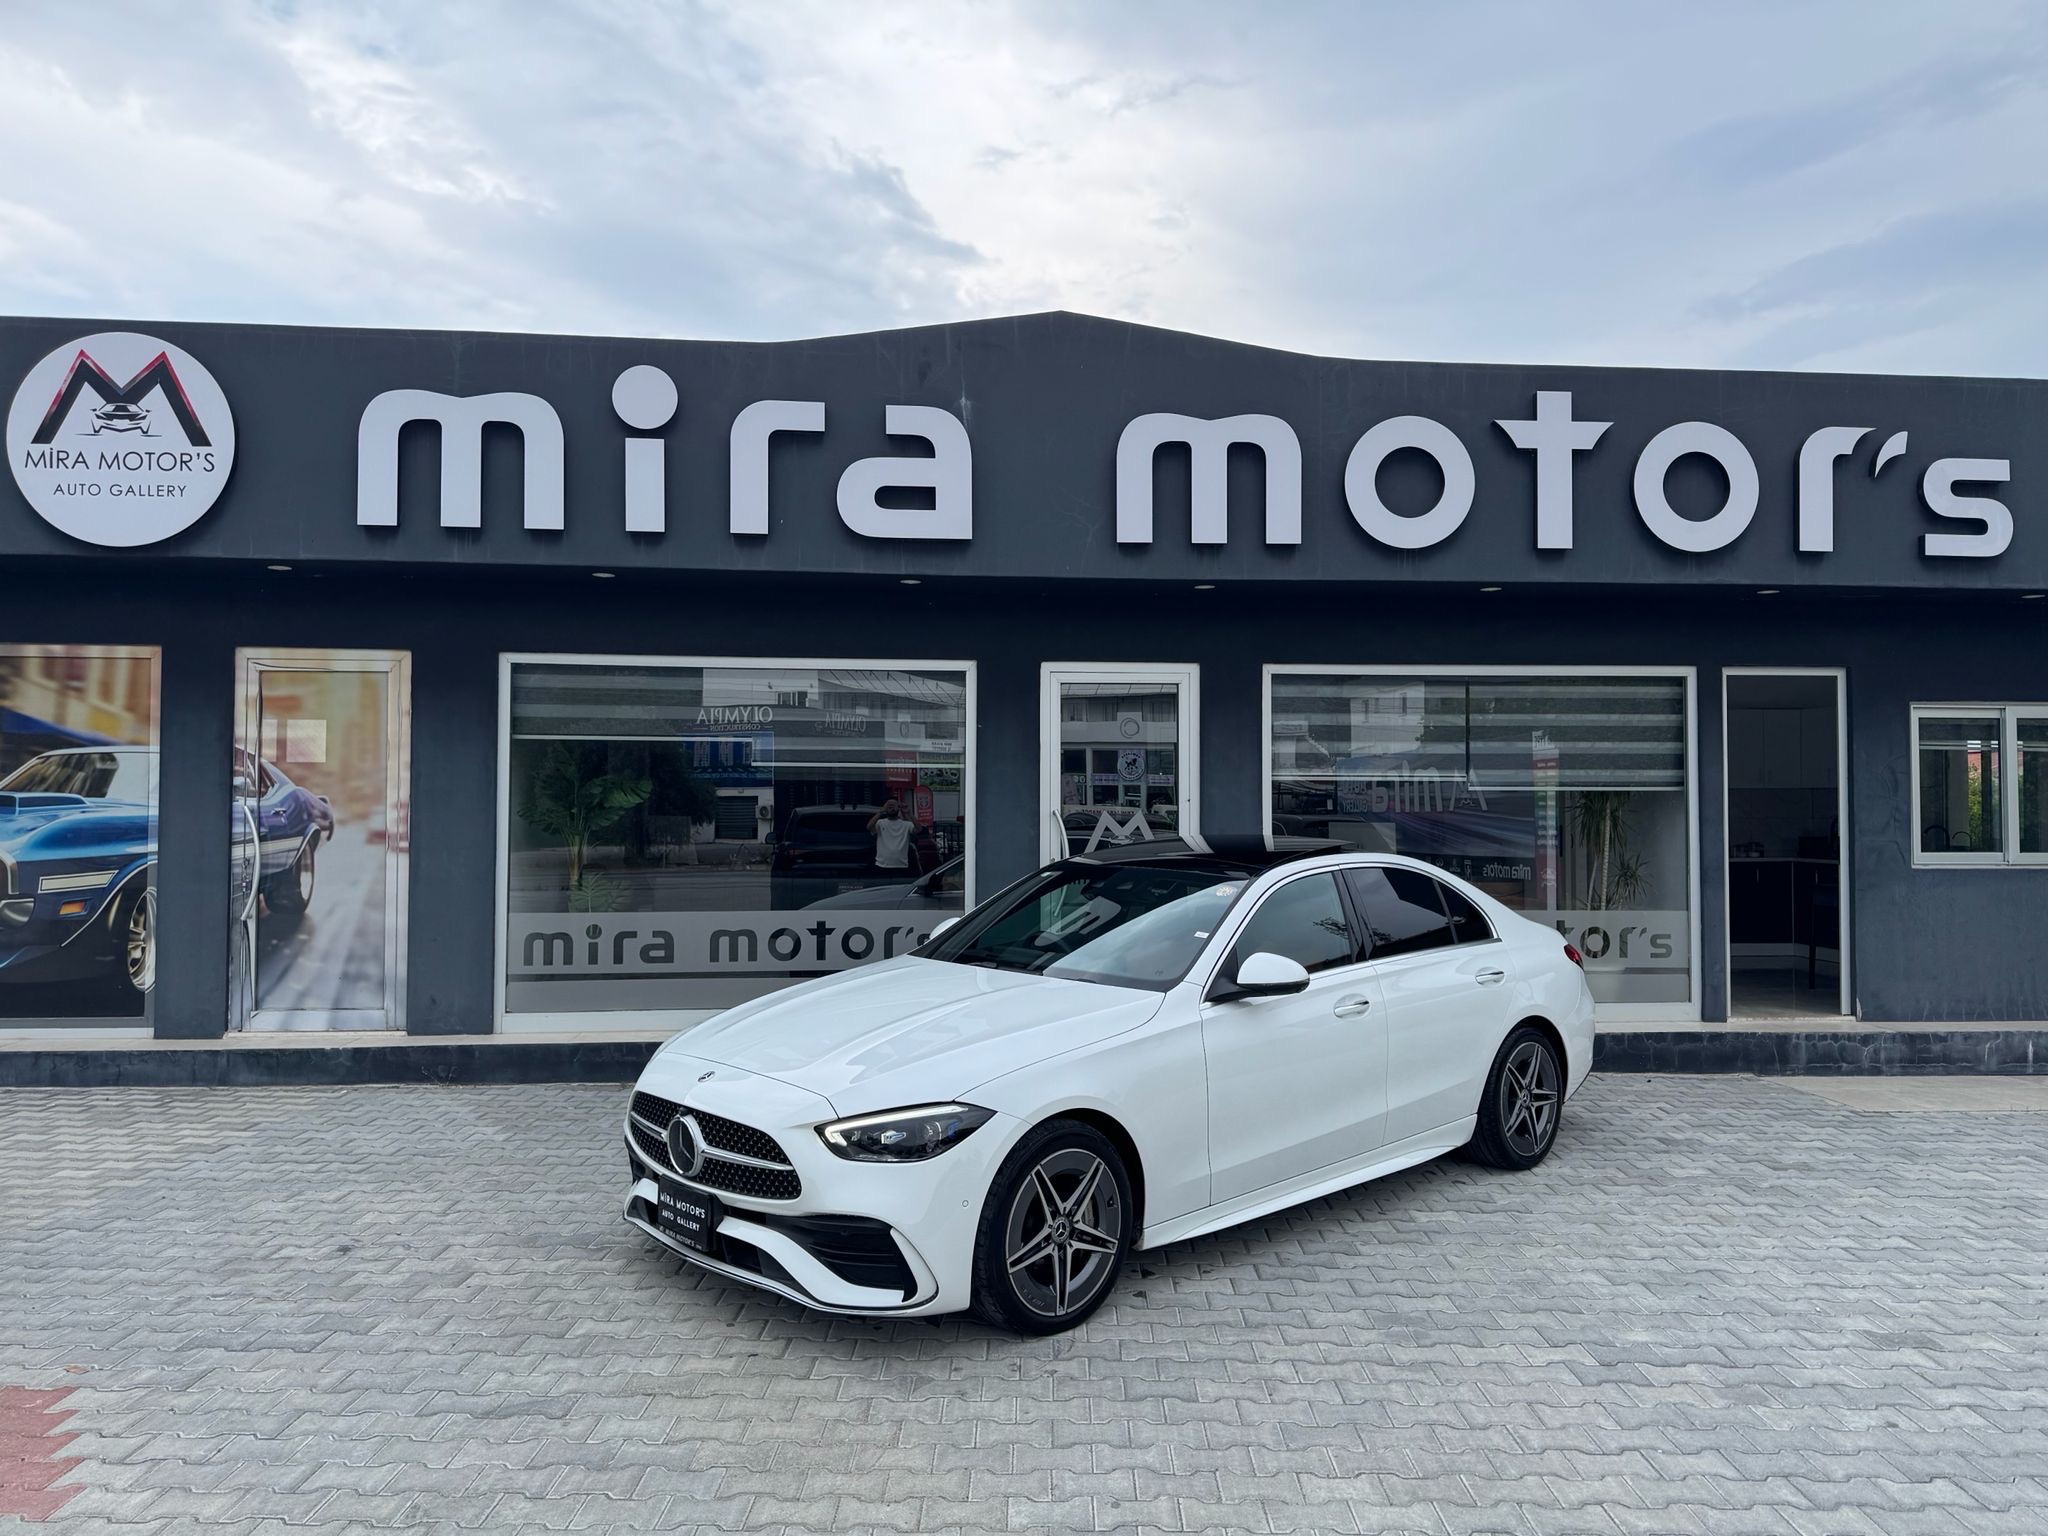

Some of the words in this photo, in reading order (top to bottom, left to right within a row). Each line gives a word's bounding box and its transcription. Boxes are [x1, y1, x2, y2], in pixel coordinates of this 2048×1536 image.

[98, 451, 216, 473] MOTOR'S
[355, 364, 973, 540] mira
[1115, 390, 2014, 558] motor's
[53, 483, 101, 497] AUTO
[109, 484, 187, 498] GALLERY
[523, 924, 675, 966] mira
[662, 1209, 674, 1220] AUTO
[677, 1216, 700, 1231] GALLERY
